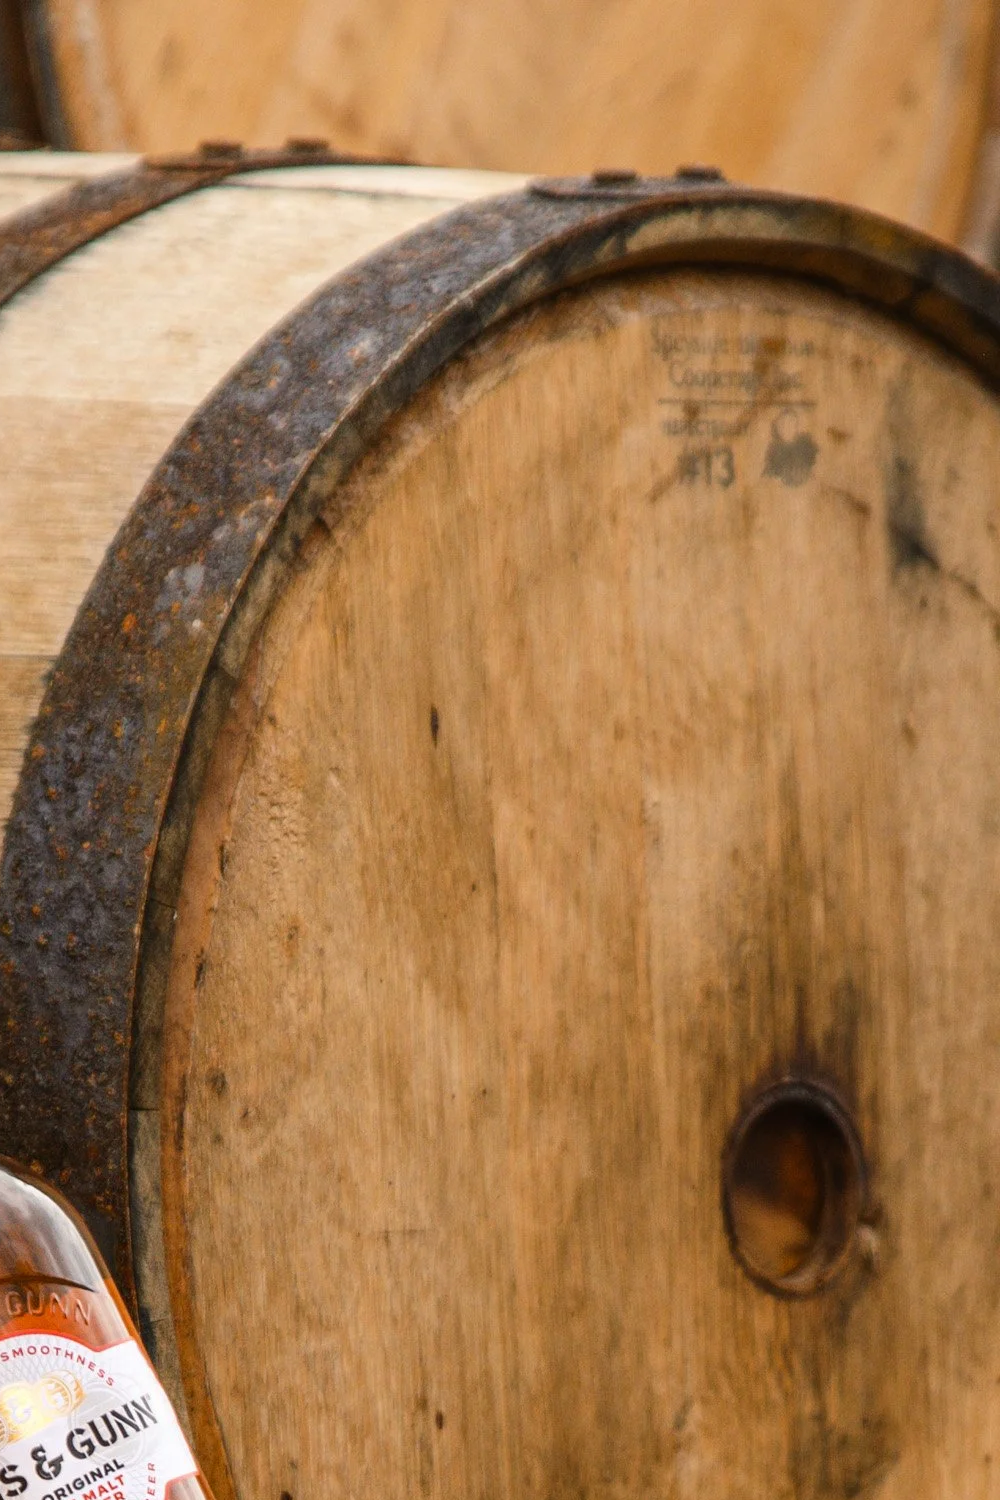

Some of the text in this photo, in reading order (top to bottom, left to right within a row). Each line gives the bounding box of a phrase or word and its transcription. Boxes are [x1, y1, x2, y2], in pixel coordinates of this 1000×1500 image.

[4, 1290, 91, 1325] GUNN
[0, 1345, 114, 1387] SMOOTHNESS
[30, 1443, 64, 1481] &
[66, 1397, 158, 1460] GUNN
